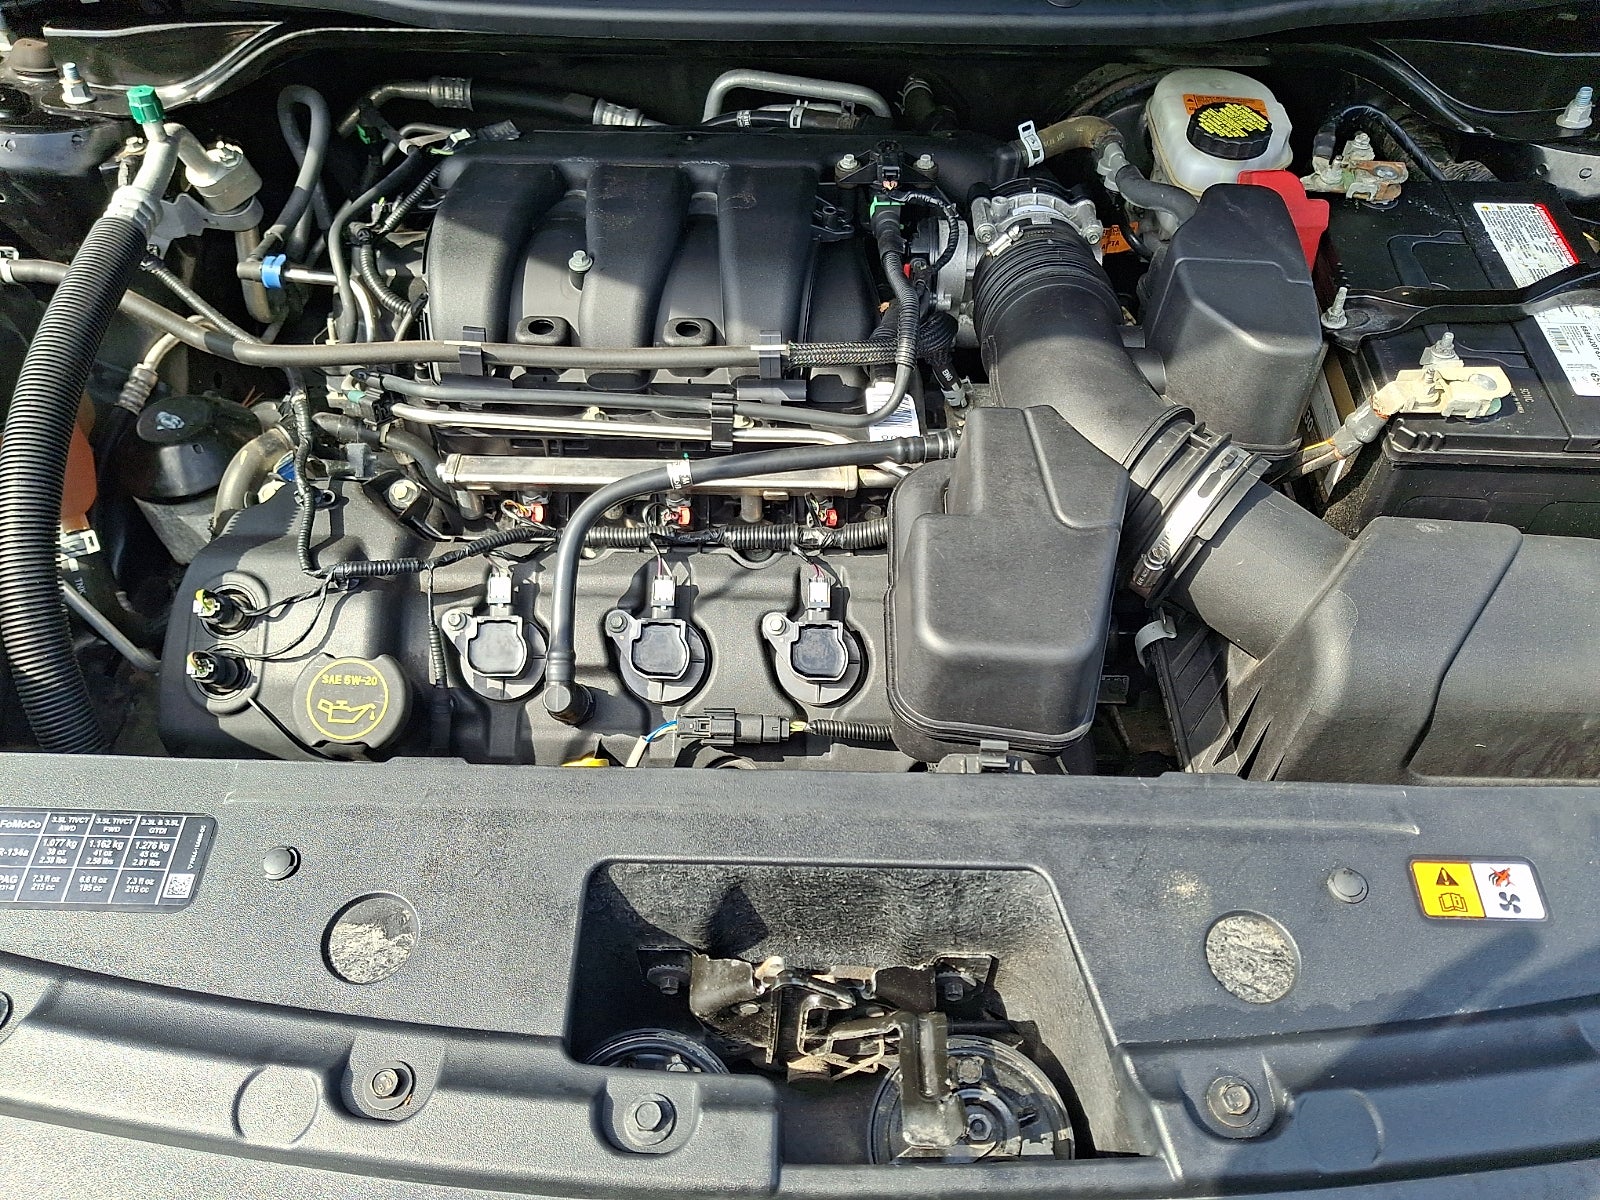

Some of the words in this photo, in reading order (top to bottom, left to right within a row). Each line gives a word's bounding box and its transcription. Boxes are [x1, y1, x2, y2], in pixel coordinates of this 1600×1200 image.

[322, 674, 342, 685] SAE
[343, 675, 378, 686] 5W-20
[0, 819, 42, 829] FoMoCo
[43, 838, 66, 847] 1.077
[66, 838, 79, 849] kg
[89, 840, 112, 849] 1.162
[113, 840, 125, 850] kg
[135, 841, 158, 850] 1.276
[159, 842, 171, 852] kg
[46, 848, 57, 856] 38
[92, 849, 102, 857] 41
[139, 850, 150, 858] 45
[55, 856, 68, 865] lbs
[148, 859, 161, 867] lbs
[31, 883, 46, 891] 215
[124, 885, 140, 893] 215
